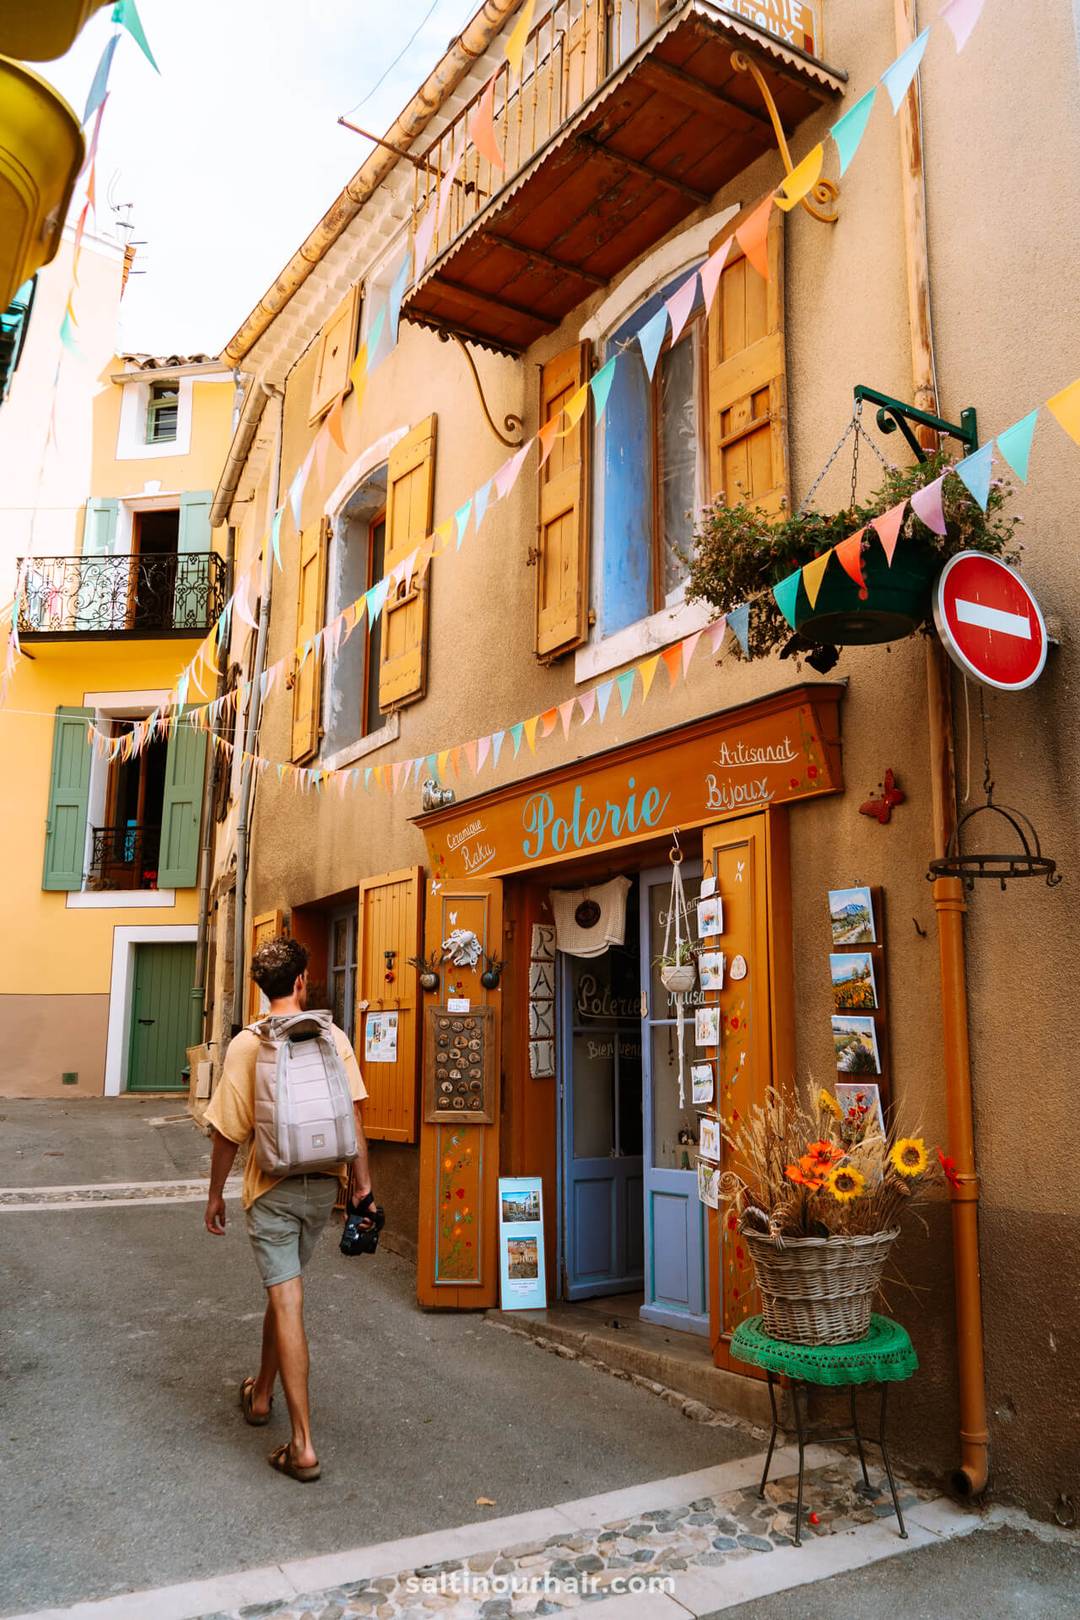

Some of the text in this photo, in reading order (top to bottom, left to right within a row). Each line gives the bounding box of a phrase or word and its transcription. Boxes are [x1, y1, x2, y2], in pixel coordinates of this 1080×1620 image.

[718, 735, 795, 766] Artisanat
[704, 774, 770, 809] Bijoux
[522, 776, 672, 859] Poterie
[460, 841, 494, 871] Raku
